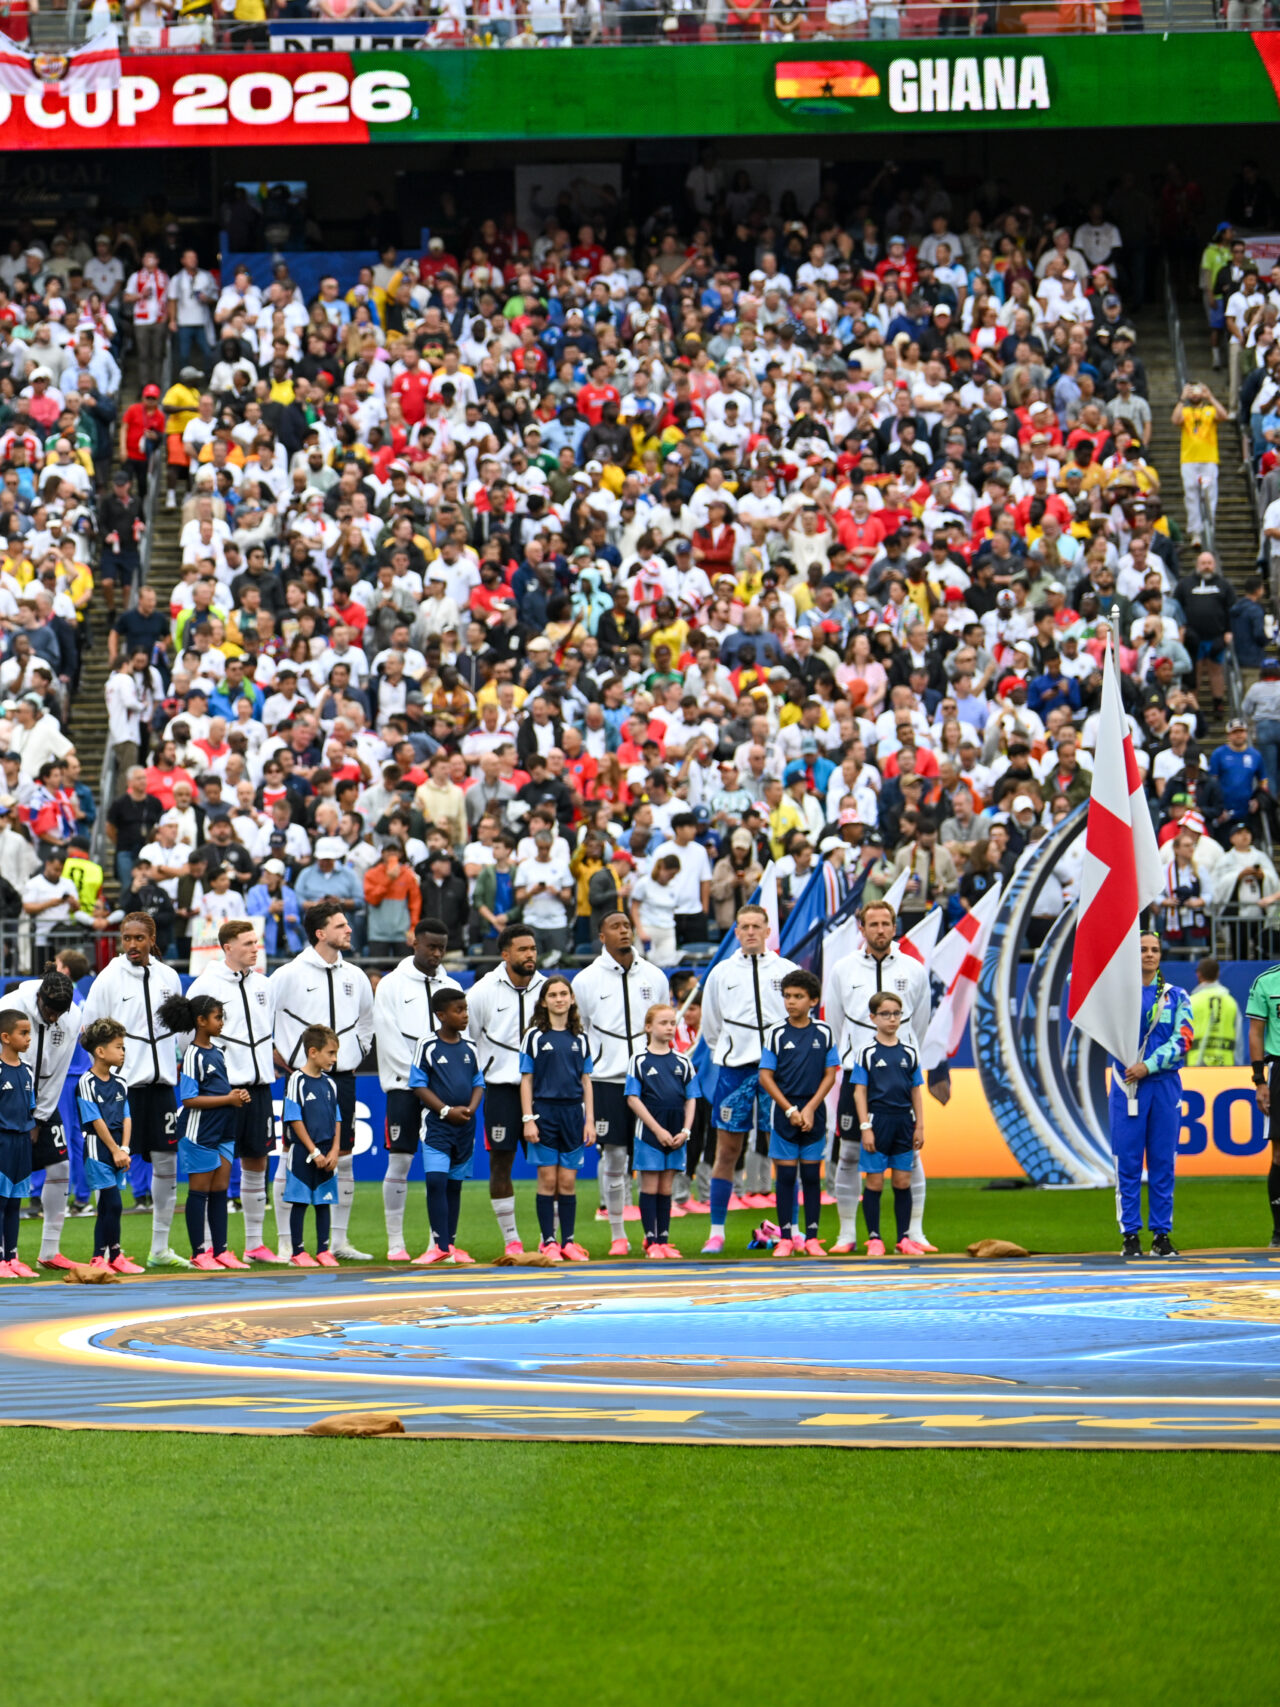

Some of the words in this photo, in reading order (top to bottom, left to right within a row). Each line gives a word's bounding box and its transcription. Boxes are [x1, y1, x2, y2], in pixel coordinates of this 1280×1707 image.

[24, 74, 160, 128] CUP
[172, 71, 412, 125] 2026
[888, 57, 1050, 112] GHANA
[96, 1396, 707, 1423] FIFA
